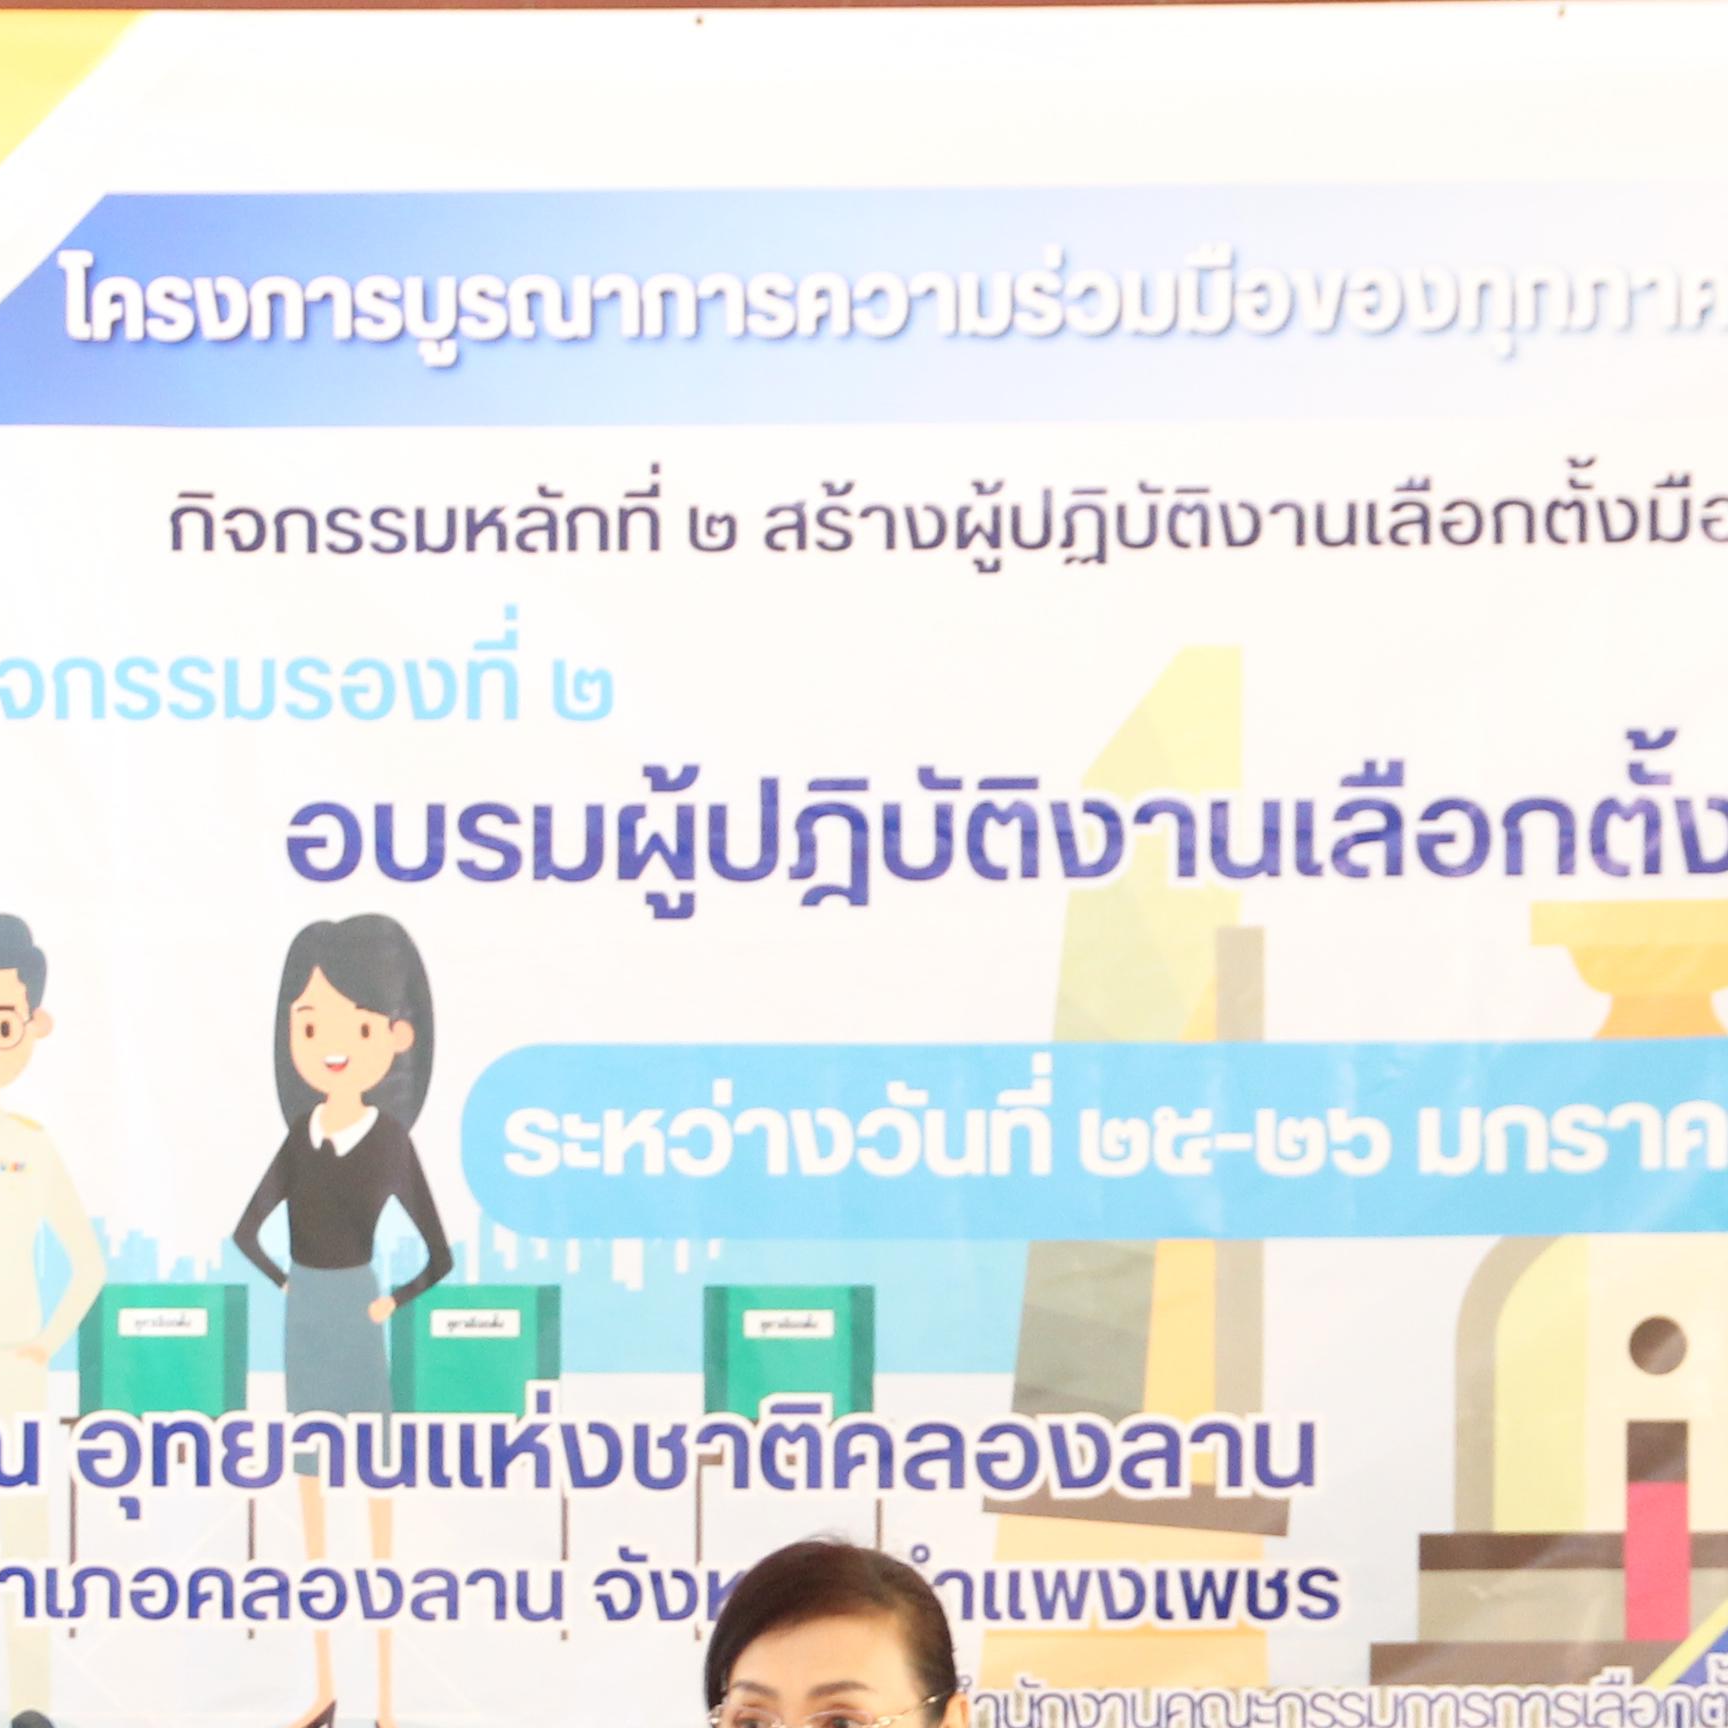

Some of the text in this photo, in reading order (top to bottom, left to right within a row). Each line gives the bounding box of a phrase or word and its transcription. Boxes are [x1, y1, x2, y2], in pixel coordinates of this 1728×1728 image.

[168, 462, 663, 554] กิจกรรมหลักที่
[688, 502, 738, 553] ๒
[550, 652, 615, 723] ๒
[502, 1051, 1053, 1177] ระหว่างวันที่
[1076, 1105, 1393, 1178] ๒๕-๒๖
[76, 1389, 1318, 1521] อุทยานแห่งชาติคลองลาน
[593, 1544, 1342, 1622] จังหำแพงเพชร
